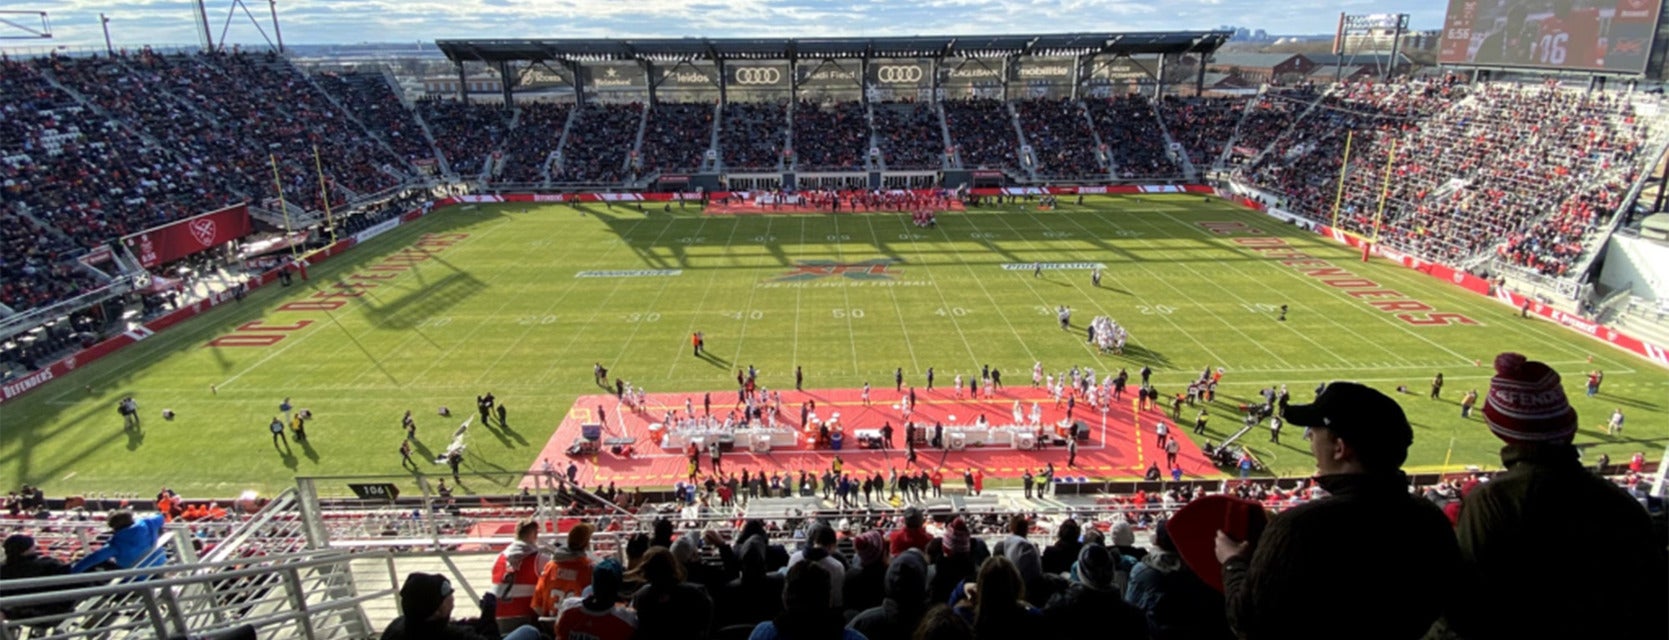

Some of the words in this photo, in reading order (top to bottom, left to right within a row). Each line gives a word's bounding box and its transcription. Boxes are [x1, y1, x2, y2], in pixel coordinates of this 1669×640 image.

[677, 71, 709, 82] leidos
[832, 308, 865, 319] 50
[934, 306, 967, 316] 40
[3, 366, 53, 399] DEFENDERS
[363, 486, 385, 494] 106
